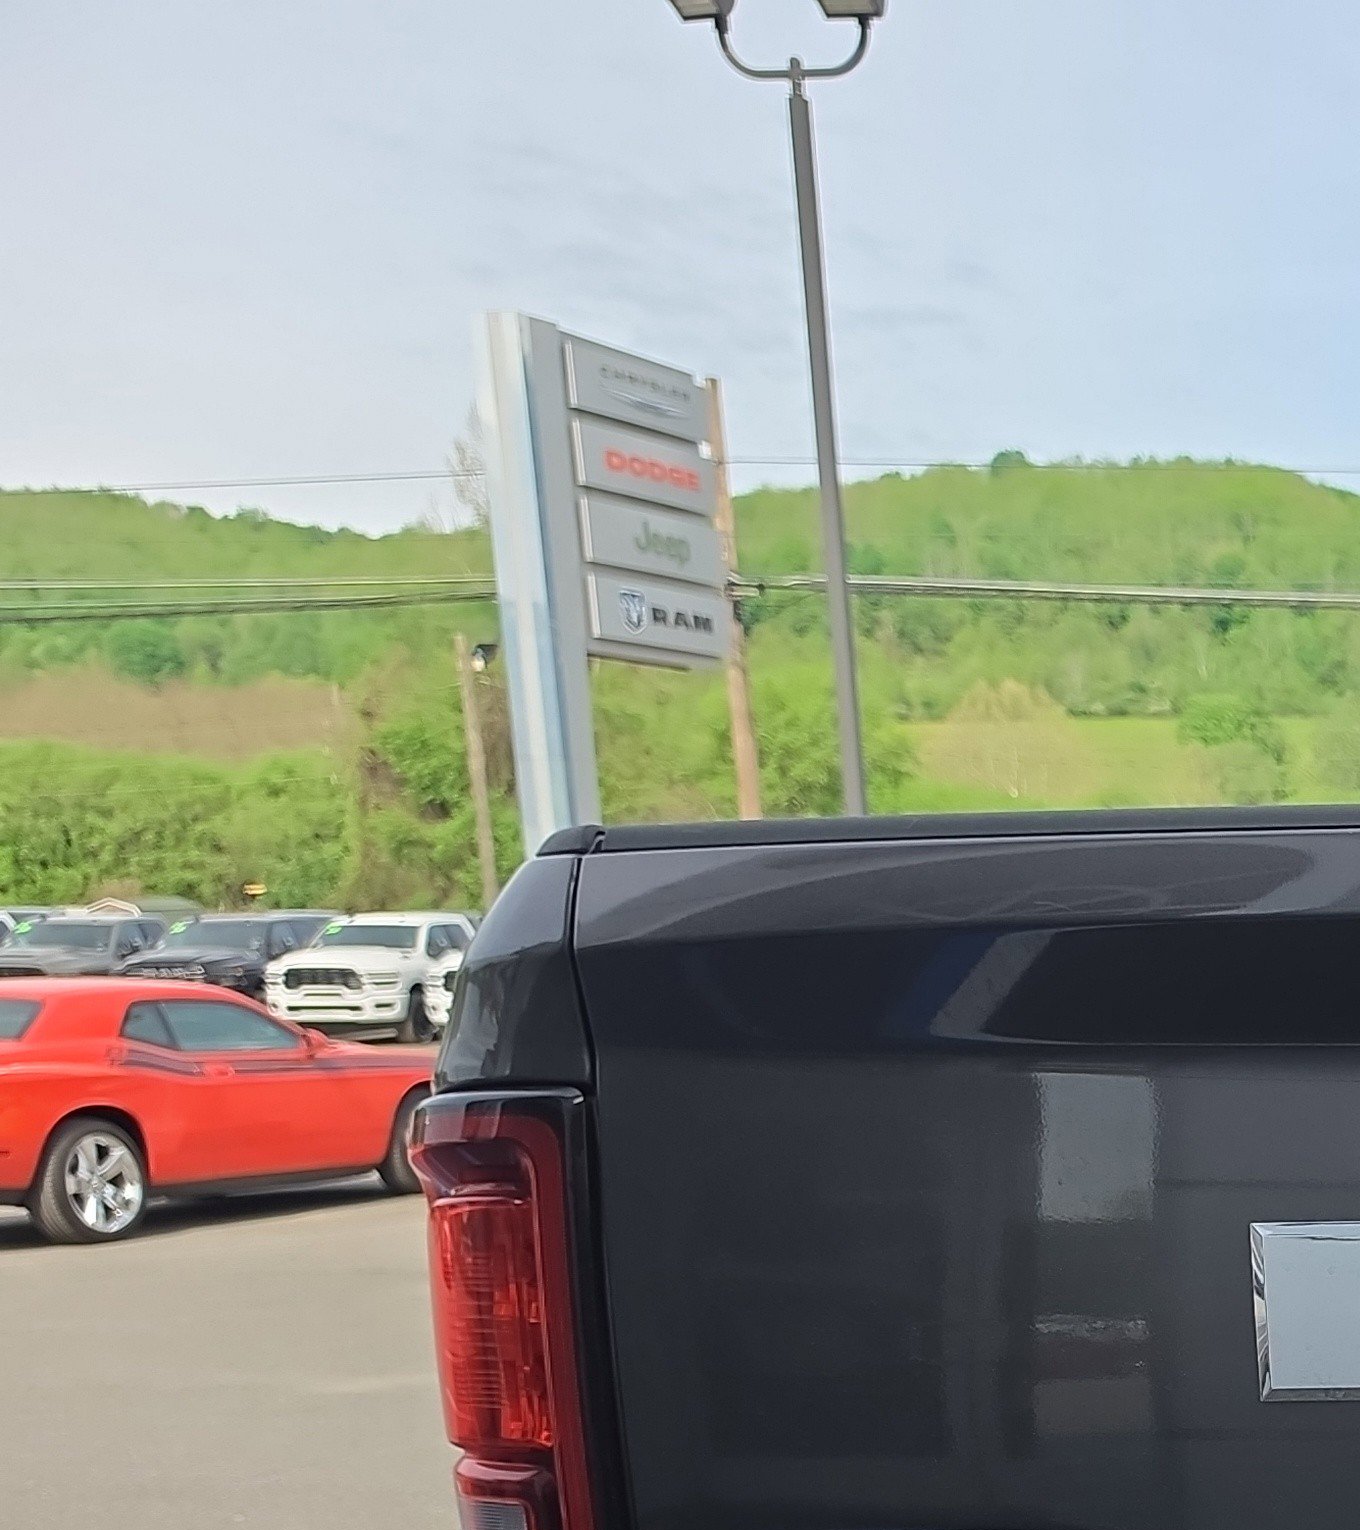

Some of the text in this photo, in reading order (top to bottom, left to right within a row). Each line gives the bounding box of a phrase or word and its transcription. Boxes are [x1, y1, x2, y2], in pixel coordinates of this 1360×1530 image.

[605, 450, 699, 490] DODGE
[634, 519, 690, 567] Jeep
[651, 605, 713, 634] RAM
